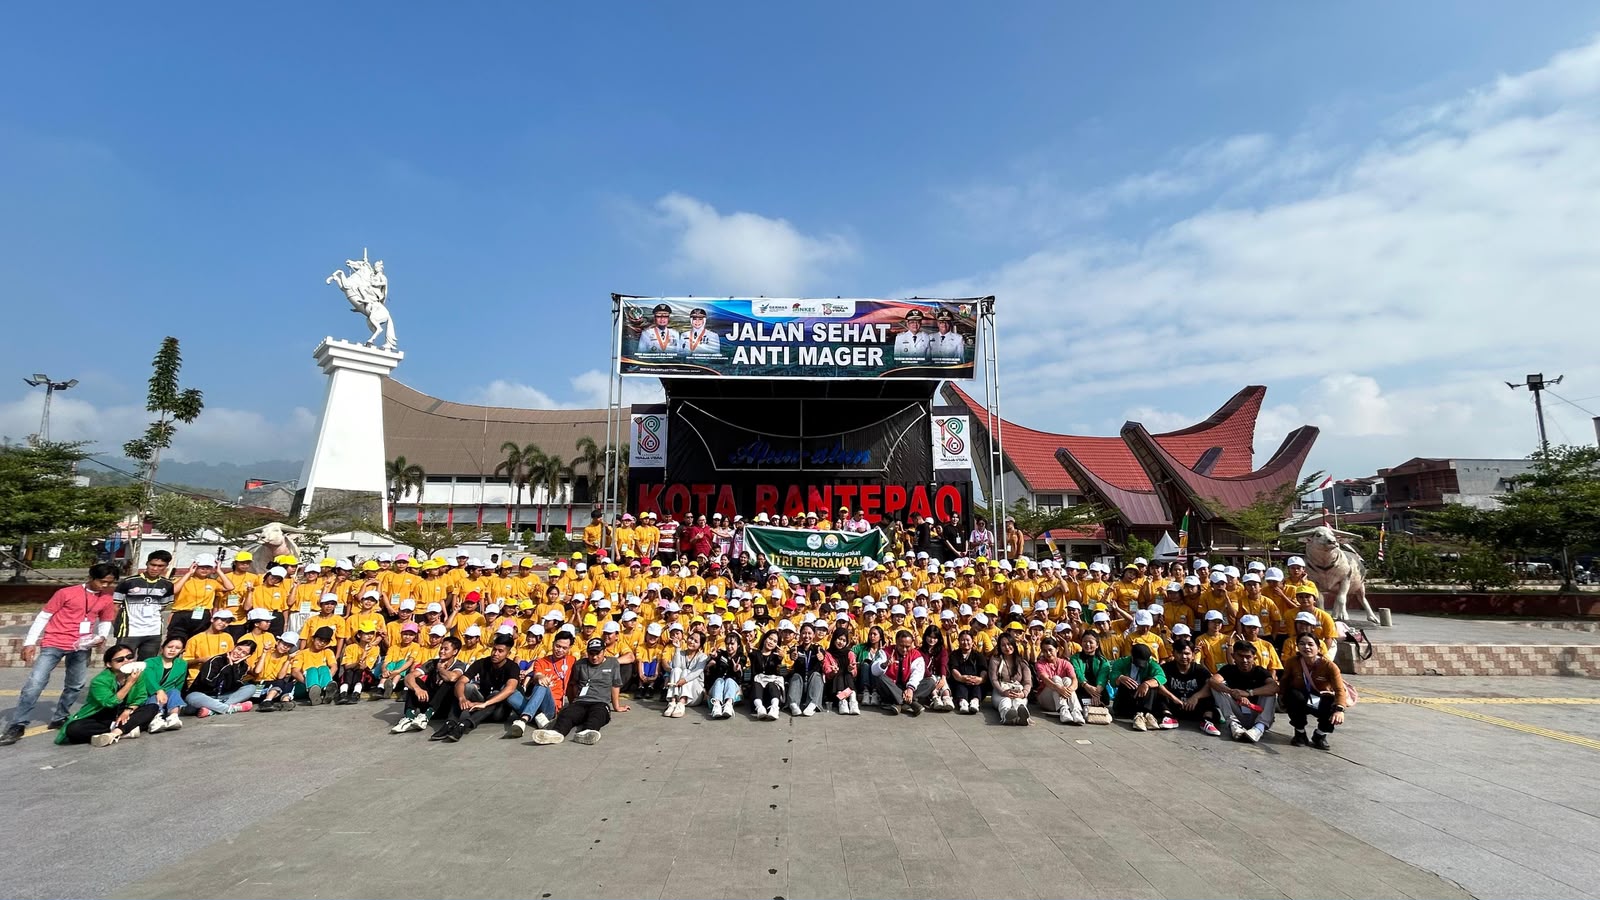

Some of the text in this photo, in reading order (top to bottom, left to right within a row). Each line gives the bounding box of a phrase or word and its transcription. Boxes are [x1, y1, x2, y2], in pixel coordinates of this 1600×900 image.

[725, 322, 891, 343] JALAN SEHAT
[732, 346, 884, 366] ANTI MAGER
[638, 483, 963, 525] KOTA RANTEPAO
[779, 548, 810, 557] Pengabdian
[832, 550, 861, 558] Masyarakat
